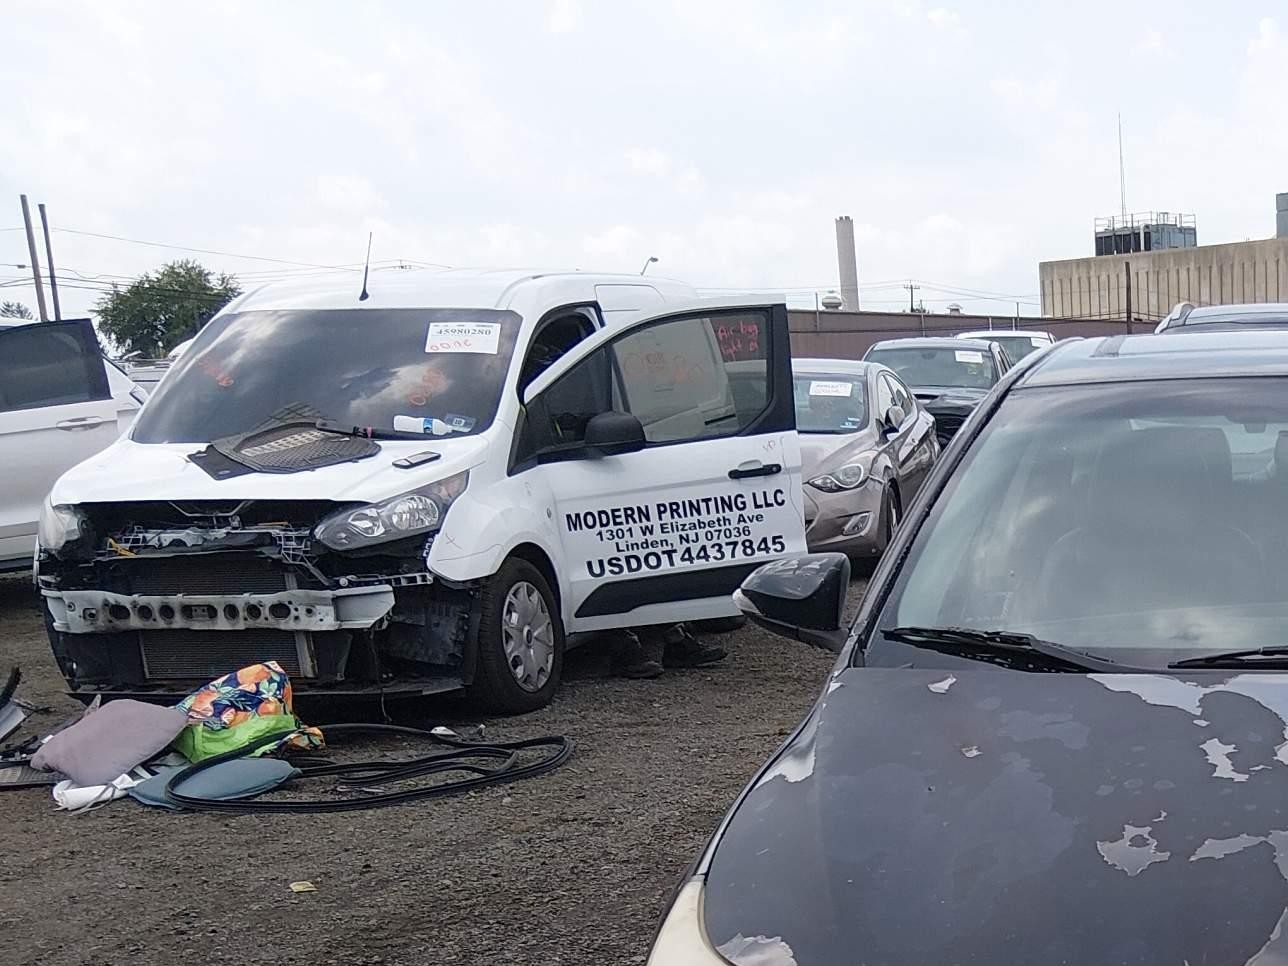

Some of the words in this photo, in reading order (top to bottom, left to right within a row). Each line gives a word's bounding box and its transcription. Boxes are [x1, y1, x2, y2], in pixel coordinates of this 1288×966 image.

[565, 506, 651, 531] MODERN
[657, 493, 747, 521] PRINTING
[753, 488, 786, 509] LLC
[596, 526, 634, 542] 1301
[640, 524, 655, 536] W
[660, 516, 732, 534] Elizabeth
[737, 511, 765, 525] Ave
[587, 534, 787, 578] USDOT4437845
[616, 537, 674, 554] Linden,
[679, 532, 700, 544] NJ
[705, 525, 752, 541] 07036
